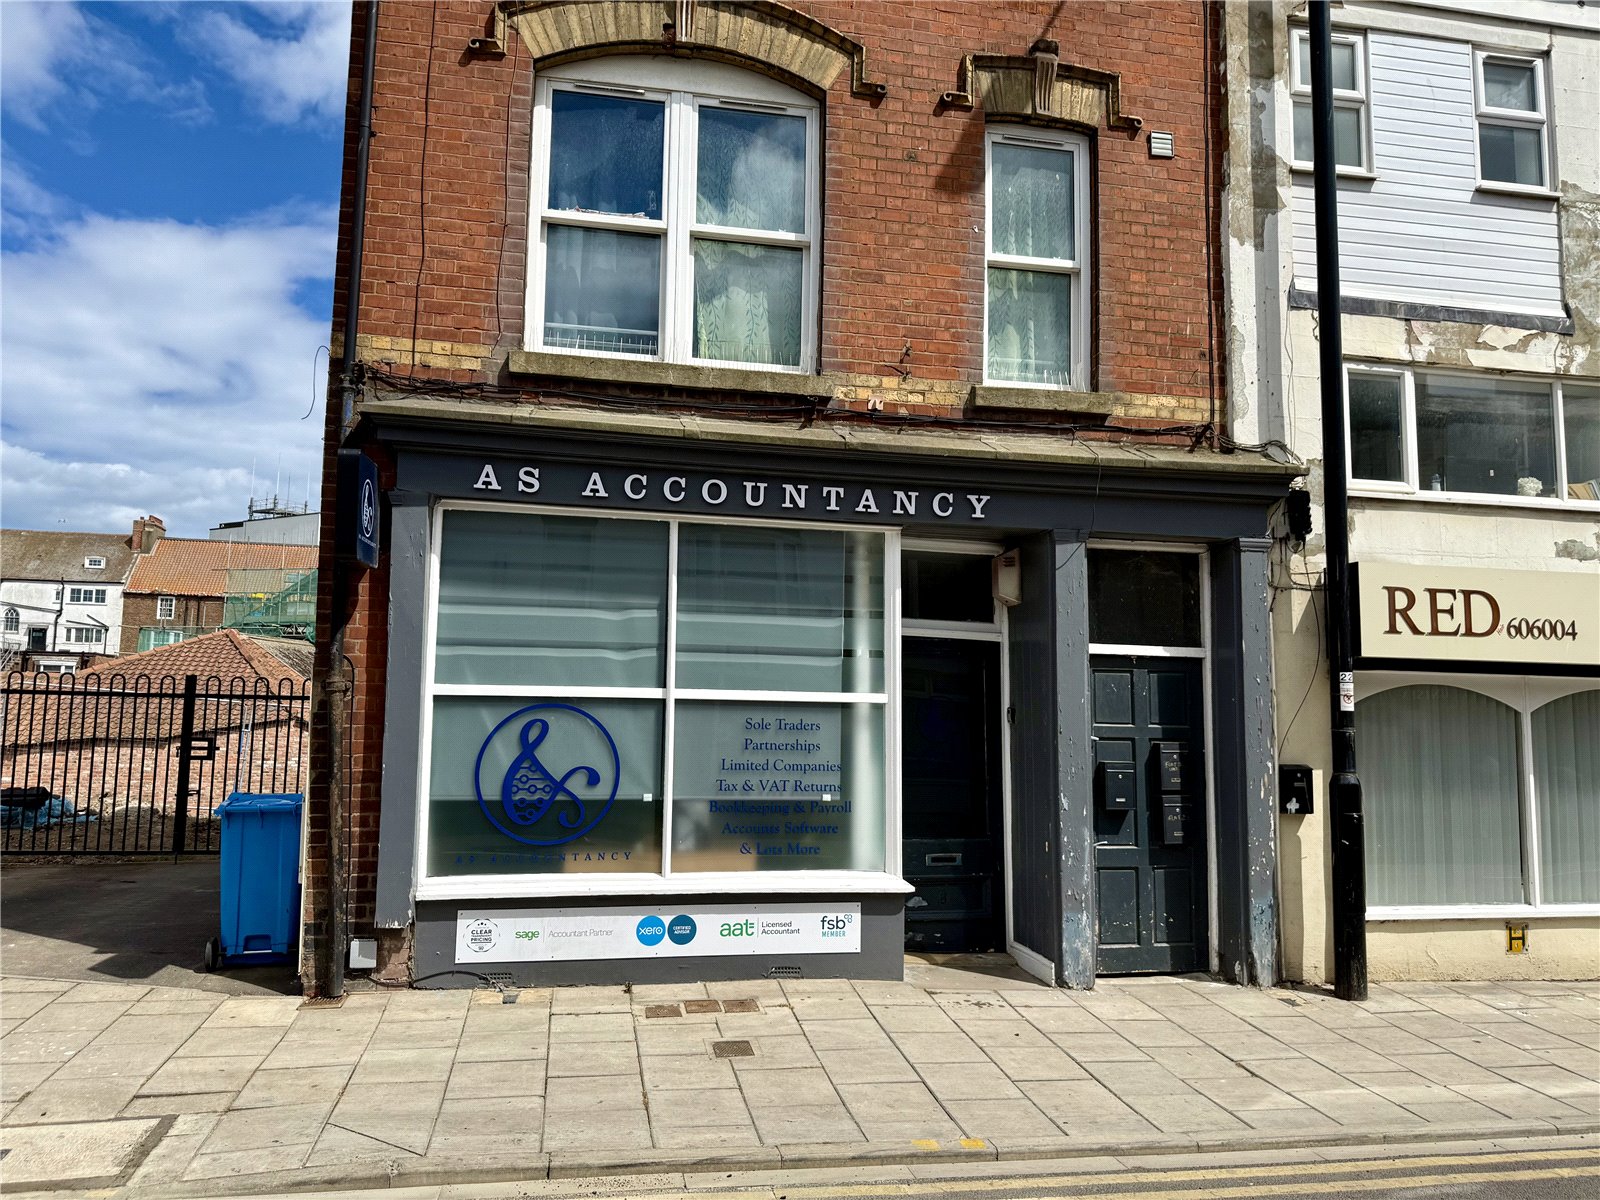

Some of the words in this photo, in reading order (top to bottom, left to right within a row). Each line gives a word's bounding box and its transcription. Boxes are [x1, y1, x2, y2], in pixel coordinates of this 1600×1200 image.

[473, 463, 541, 494] AS
[582, 471, 991, 519] ACCOUNTANCY
[1382, 586, 1502, 638] RED
[1506, 617, 1578, 641] 606004
[745, 717, 771, 731] Sole
[776, 718, 821, 731] Traders
[744, 738, 821, 753] Partnerships
[721, 758, 769, 772] Limited
[773, 758, 842, 774] Companies
[716, 779, 738, 792] Tax
[743, 779, 755, 792] &
[759, 779, 790, 792] VAT
[794, 779, 842, 792] Returns
[709, 800, 790, 815] Bookkeeping
[794, 801, 806, 814] &
[811, 800, 852, 815] Payroll
[722, 822, 780, 834] Accounts
[785, 822, 839, 834] Software
[740, 842, 752, 855] &
[756, 842, 783, 855] Lots
[788, 842, 821, 855] More
[719, 918, 755, 937] aat
[761, 920, 792, 928] Licensed
[820, 915, 846, 930] fsb
[515, 929, 540, 941] sage
[548, 929, 588, 938] Accountant
[589, 928, 614, 937] Partner
[639, 926, 664, 936] xero
[761, 926, 800, 936] Accountant
